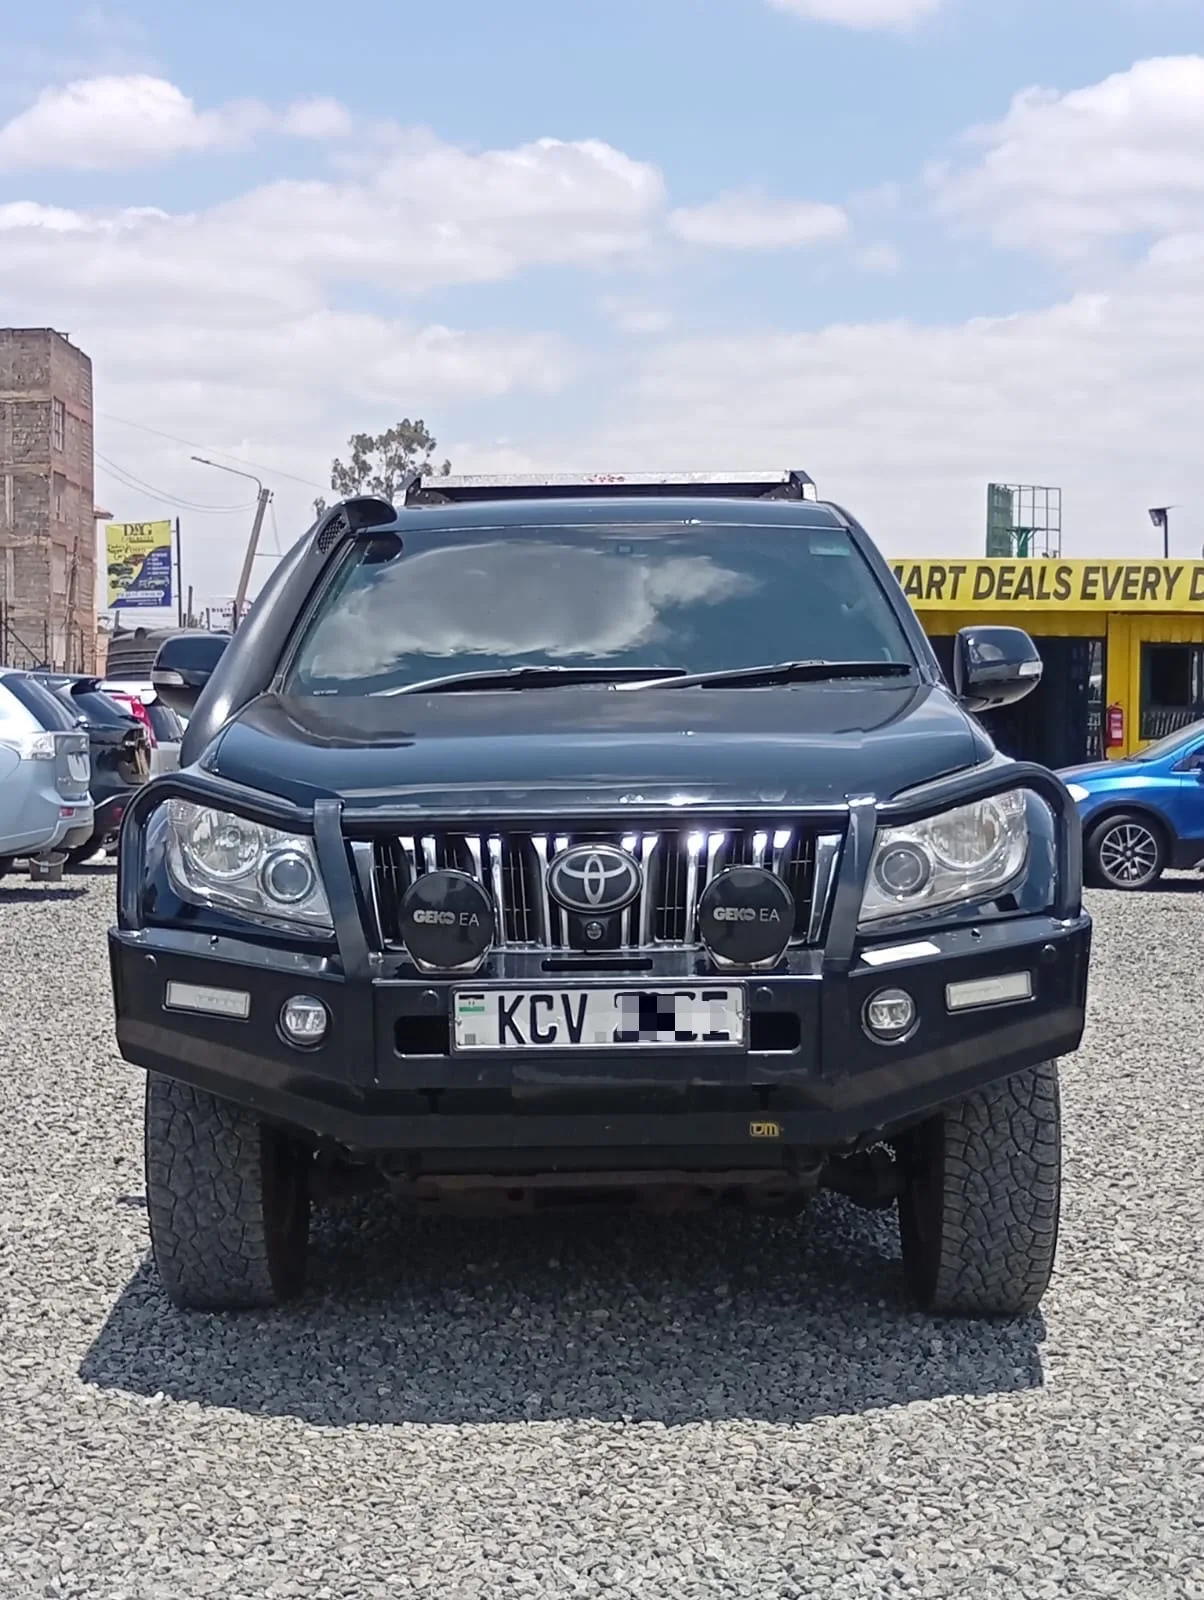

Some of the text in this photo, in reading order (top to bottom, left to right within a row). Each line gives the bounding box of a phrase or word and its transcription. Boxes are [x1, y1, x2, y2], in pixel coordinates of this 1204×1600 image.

[972, 565, 1073, 601] DEALS
[1080, 566, 1184, 600] EVERY
[413, 909, 480, 927] GEKO EA
[713, 906, 780, 923] GEKO EA
[498, 993, 588, 1045] KCV
